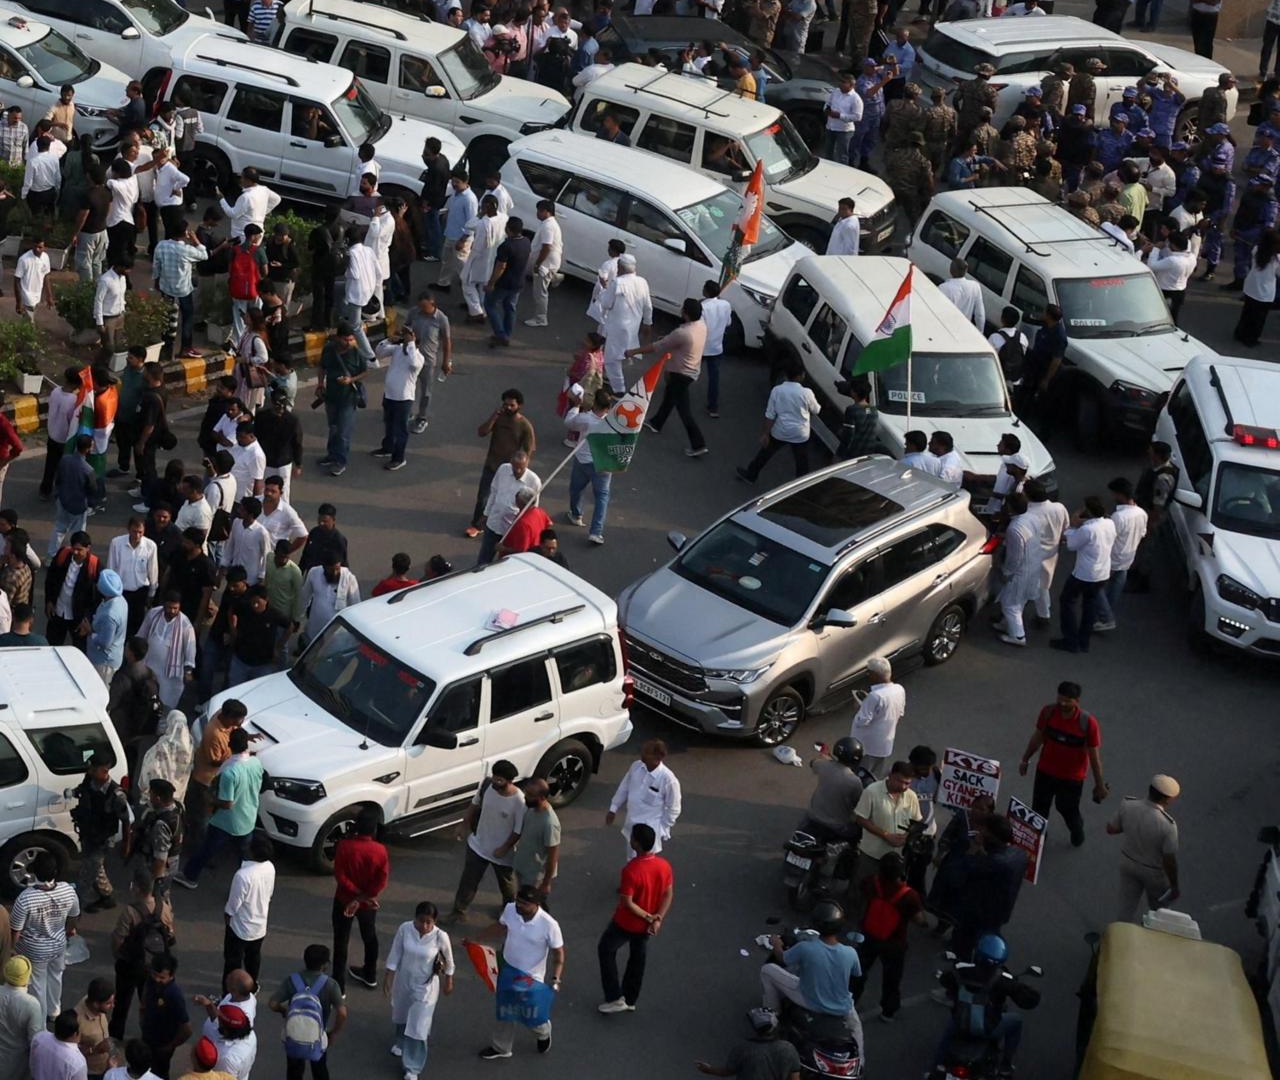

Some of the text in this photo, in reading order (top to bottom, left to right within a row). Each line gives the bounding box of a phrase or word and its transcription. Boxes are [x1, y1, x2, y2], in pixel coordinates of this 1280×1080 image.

[891, 391, 923, 401] POLCE
[947, 751, 999, 775] KYS
[942, 778, 994, 797] GYANE
[952, 768, 985, 788] SACK
[945, 791, 975, 808] KUM
[1010, 800, 1044, 831] KYS
